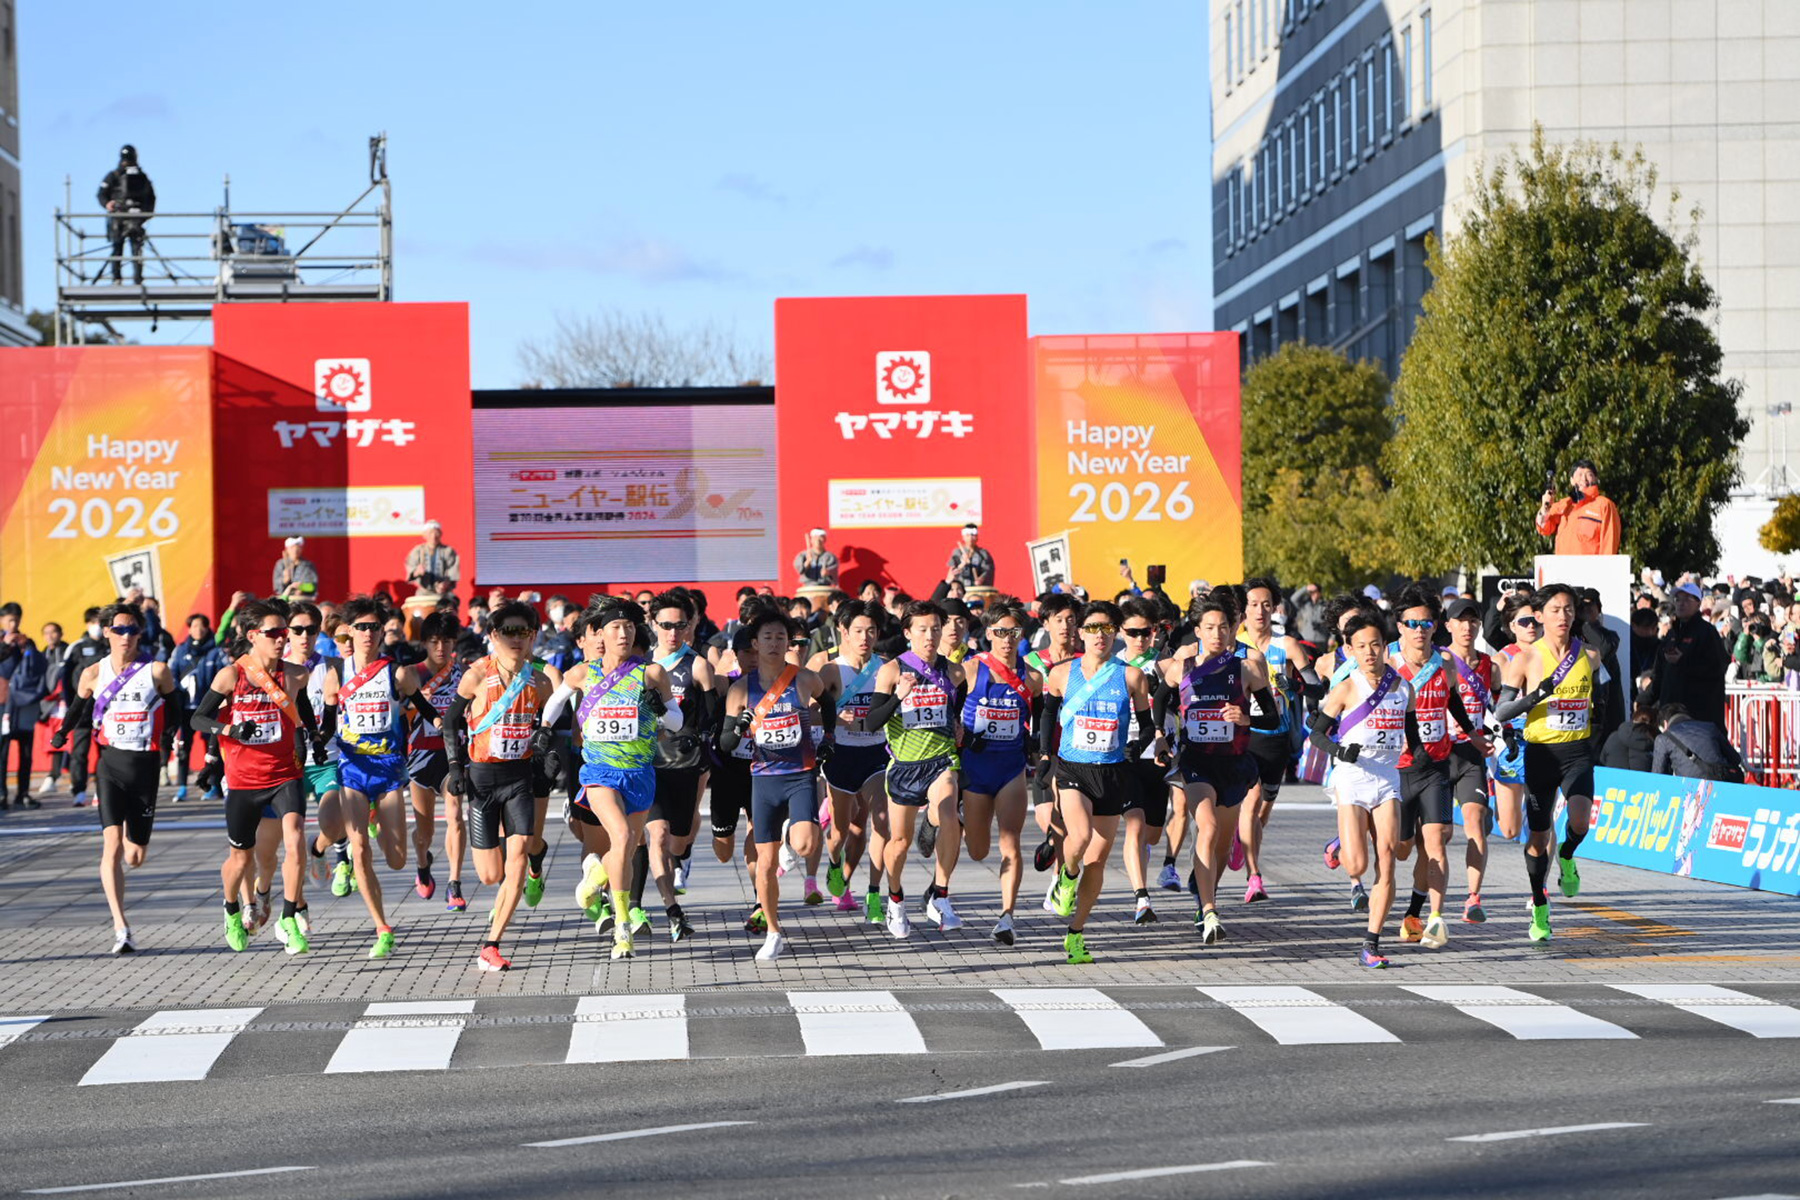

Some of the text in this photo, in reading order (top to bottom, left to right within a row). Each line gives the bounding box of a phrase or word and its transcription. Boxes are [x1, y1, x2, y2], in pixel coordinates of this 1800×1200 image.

[273, 419, 415, 447] ヤマザキ
[835, 410, 973, 439] ヤマザキ
[1067, 420, 1155, 449] Happy
[87, 434, 179, 464] Happy
[1068, 451, 1191, 474] New Year
[51, 466, 181, 490] New Year
[508, 484, 670, 509] ニューイヤー駅伝
[1068, 481, 1195, 523] 2026
[47, 498, 179, 539] 2026
[1190, 694, 1230, 702] SUBARU
[356, 714, 387, 728] 21-1
[914, 707, 943, 722] 13-1
[1558, 711, 1585, 725] 12-1
[254, 725, 276, 738] 6-1
[596, 720, 633, 735] 39-1
[763, 729, 797, 744] 25-1
[987, 721, 1015, 734] 6-1
[1198, 722, 1228, 736] 5-1
[1595, 787, 1681, 852] ランチパック
[1718, 823, 1746, 844] ヤマザキ
[1742, 807, 1800, 875] ランチ
